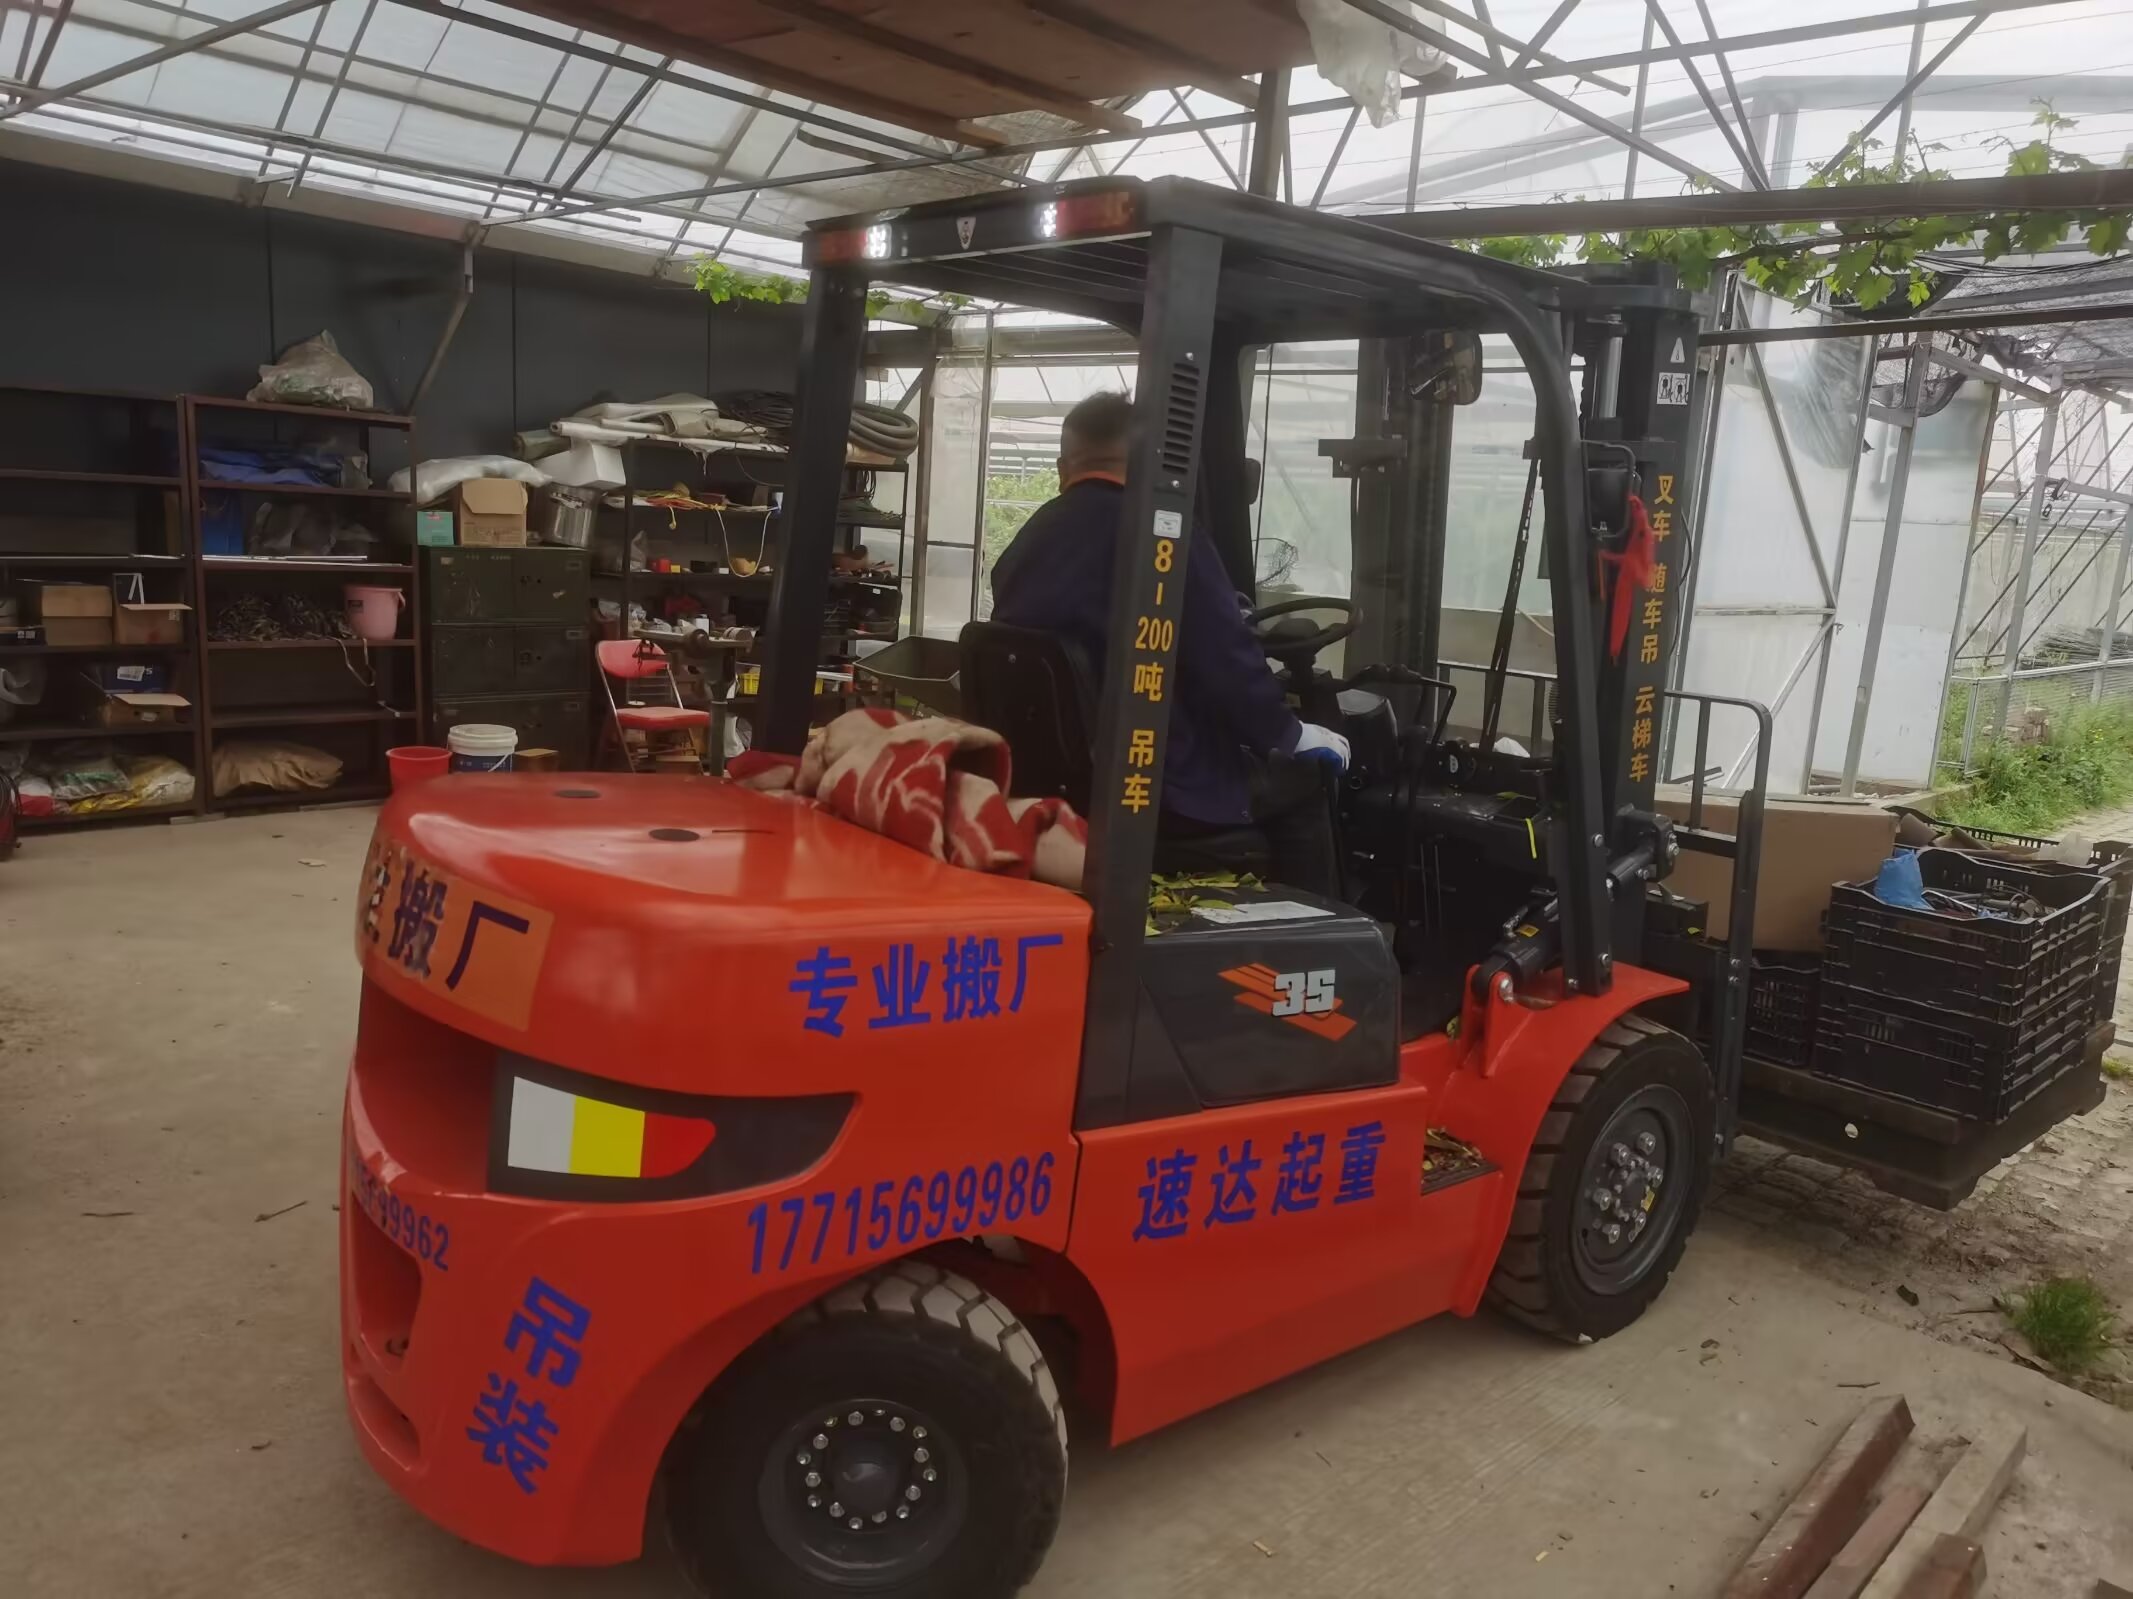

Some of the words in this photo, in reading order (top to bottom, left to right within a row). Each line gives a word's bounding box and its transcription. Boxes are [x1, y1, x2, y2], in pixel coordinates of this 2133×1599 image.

[1653, 475, 1675, 542] 叉车
[1628, 685, 1656, 783] 云梯车
[788, 933, 1064, 1038] 专业搬厂
[747, 1151, 1056, 1275] 17715699986
[1131, 1120, 1387, 1243] 速达起重
[465, 1275, 592, 1495] 吊装
